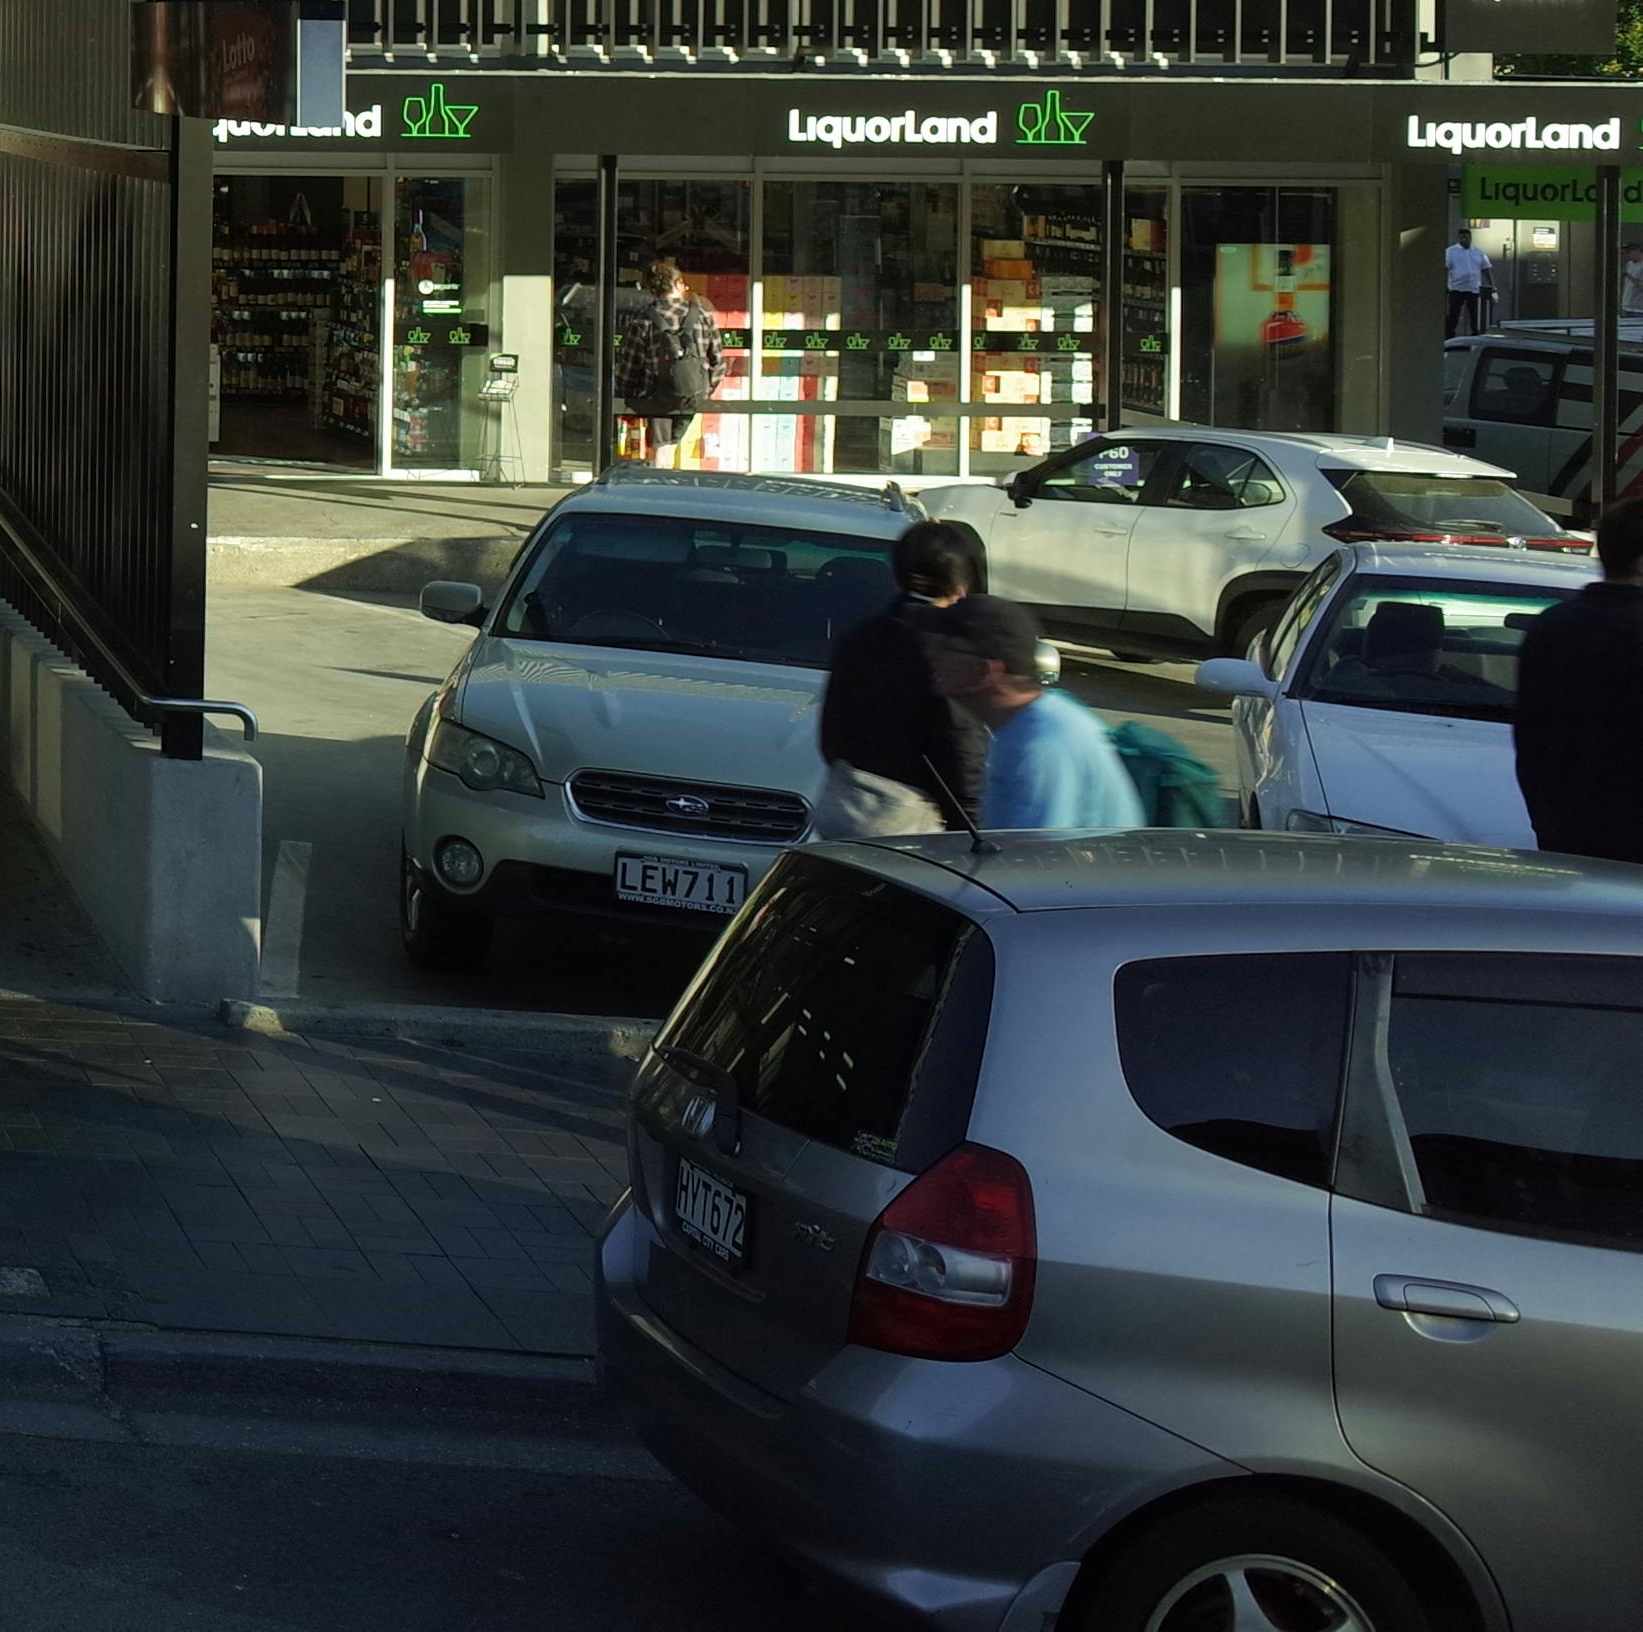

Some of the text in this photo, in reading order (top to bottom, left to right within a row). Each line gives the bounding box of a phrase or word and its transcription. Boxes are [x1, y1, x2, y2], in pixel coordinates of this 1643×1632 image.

[222, 31, 256, 72] Lotto
[1479, 176, 1643, 206] LiquorLad
[620, 862, 735, 904] LEW711
[677, 1163, 746, 1252] HYT672
